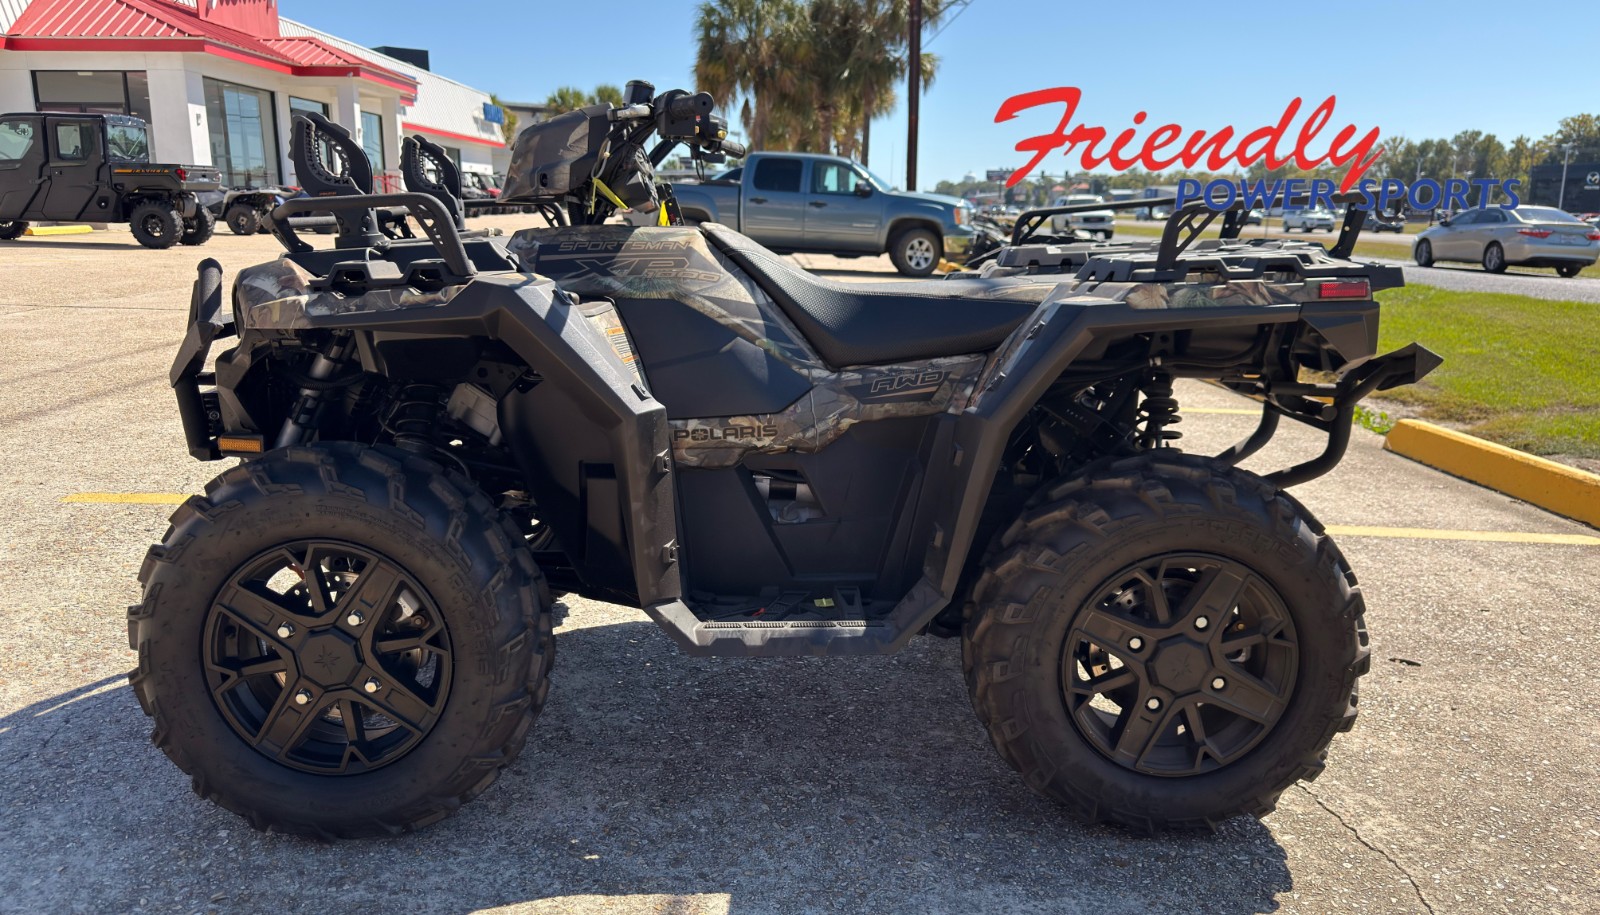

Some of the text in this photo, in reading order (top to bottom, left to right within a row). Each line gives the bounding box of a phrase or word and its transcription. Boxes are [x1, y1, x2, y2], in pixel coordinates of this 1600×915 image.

[558, 240, 691, 252] SPORTSMAN
[562, 256, 691, 282] XP
[870, 370, 946, 393] AWD
[673, 424, 779, 442] POLARIS
